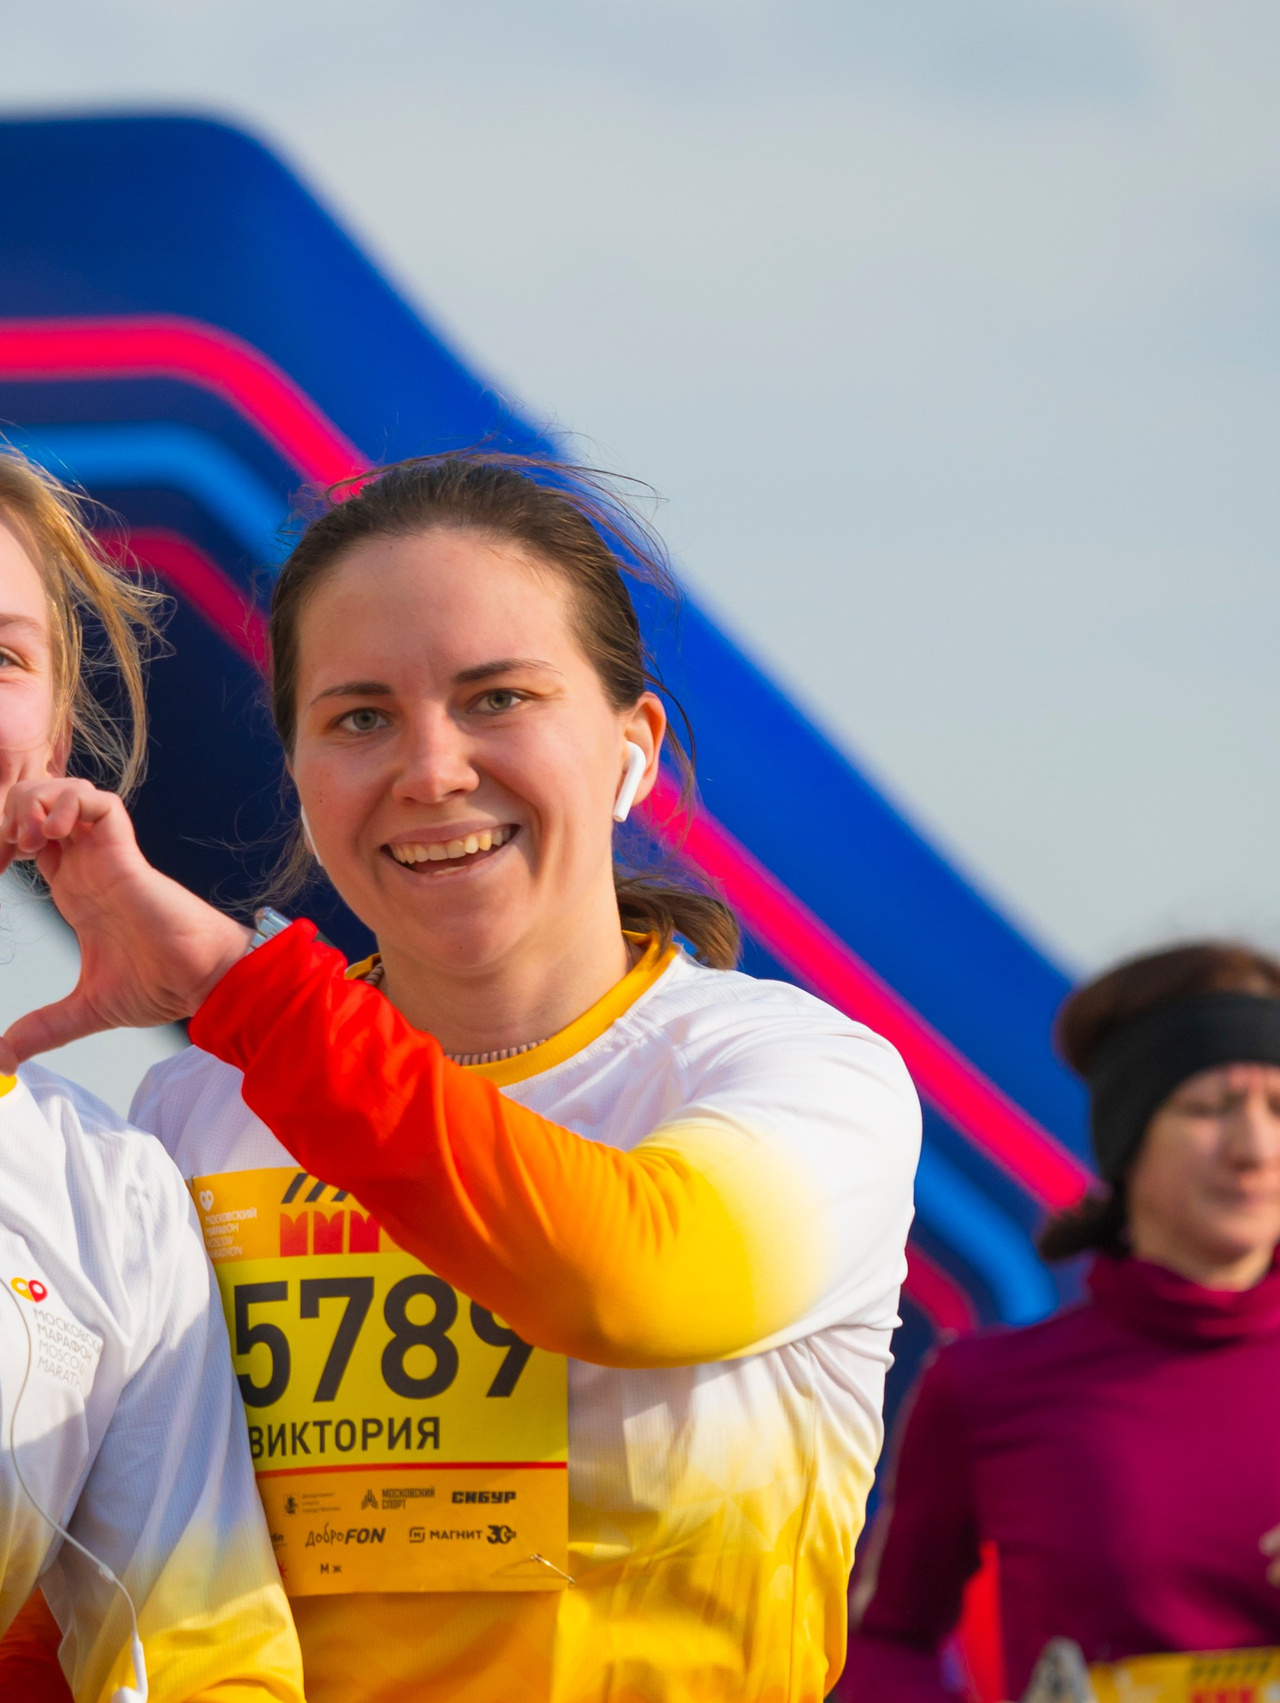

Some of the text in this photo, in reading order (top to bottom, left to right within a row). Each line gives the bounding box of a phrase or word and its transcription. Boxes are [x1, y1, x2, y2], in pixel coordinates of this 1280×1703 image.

[234, 1274, 535, 1409] 5789
[249, 1416, 441, 1460] ВИКТОРИЯ
[452, 1491, 517, 1504] СИБУР
[430, 1529, 483, 1541] МАГНИТ
